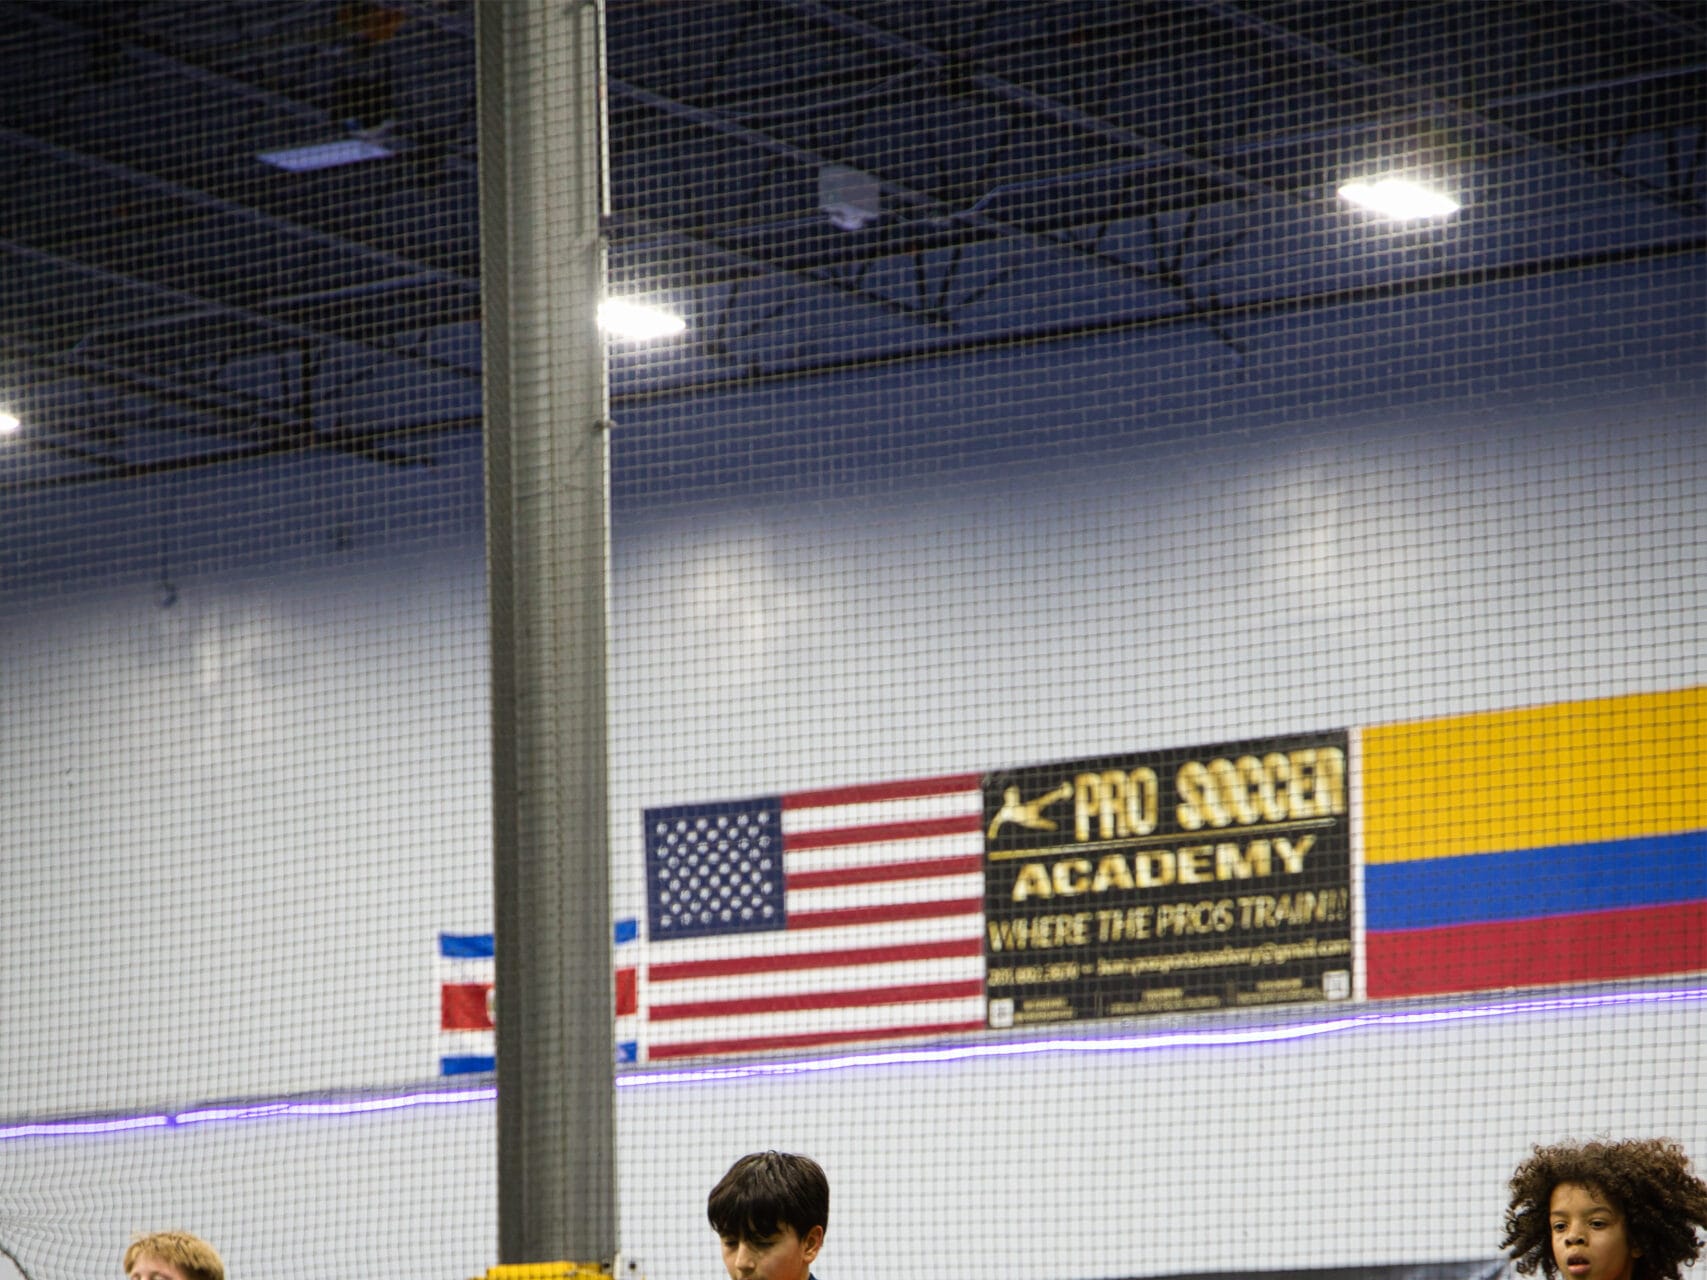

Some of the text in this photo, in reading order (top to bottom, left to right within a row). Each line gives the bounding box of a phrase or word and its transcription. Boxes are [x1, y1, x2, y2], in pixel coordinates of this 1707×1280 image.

[1074, 747, 1345, 841] PRO SOCCER
[1012, 835, 1316, 901] ACADEMY
[988, 911, 1093, 952] WHERE
[1096, 905, 1154, 943] THE
[1156, 899, 1235, 939] PROS
